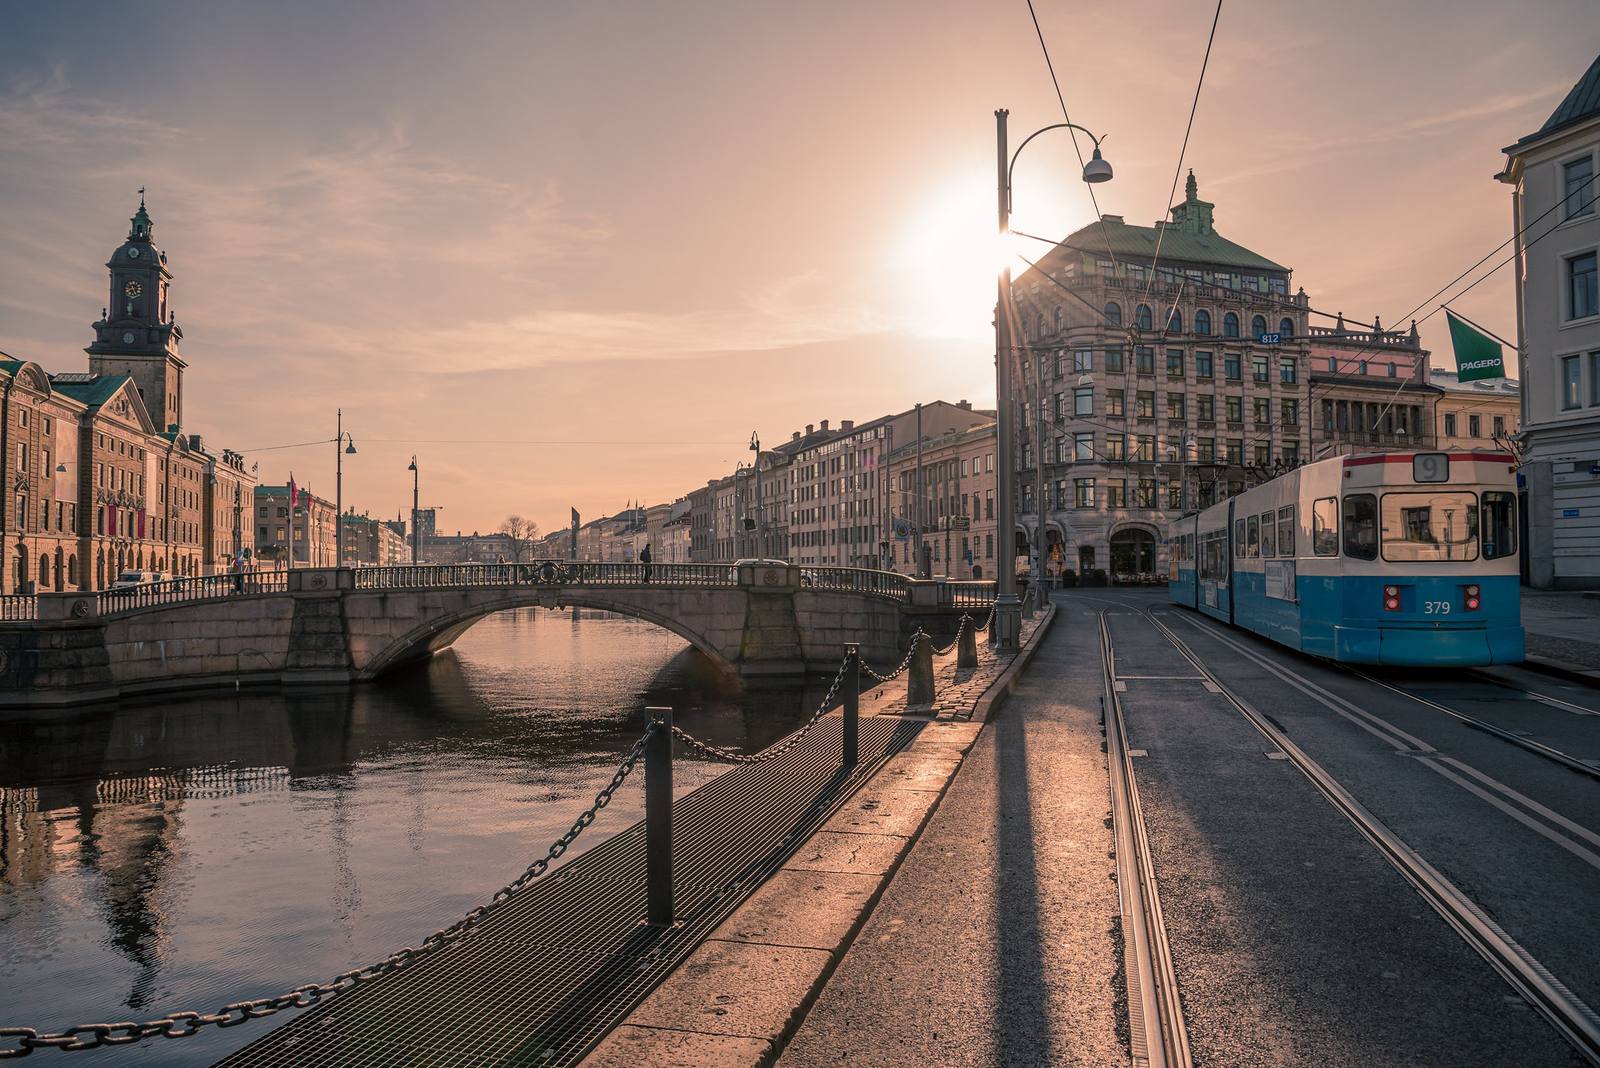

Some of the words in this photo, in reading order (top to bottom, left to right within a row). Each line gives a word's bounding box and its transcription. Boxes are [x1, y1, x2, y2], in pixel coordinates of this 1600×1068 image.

[1262, 334, 1279, 343] 812
[1460, 358, 1501, 371] PAGERO
[1422, 456, 1437, 479] 9
[1424, 601, 1450, 614] 379
